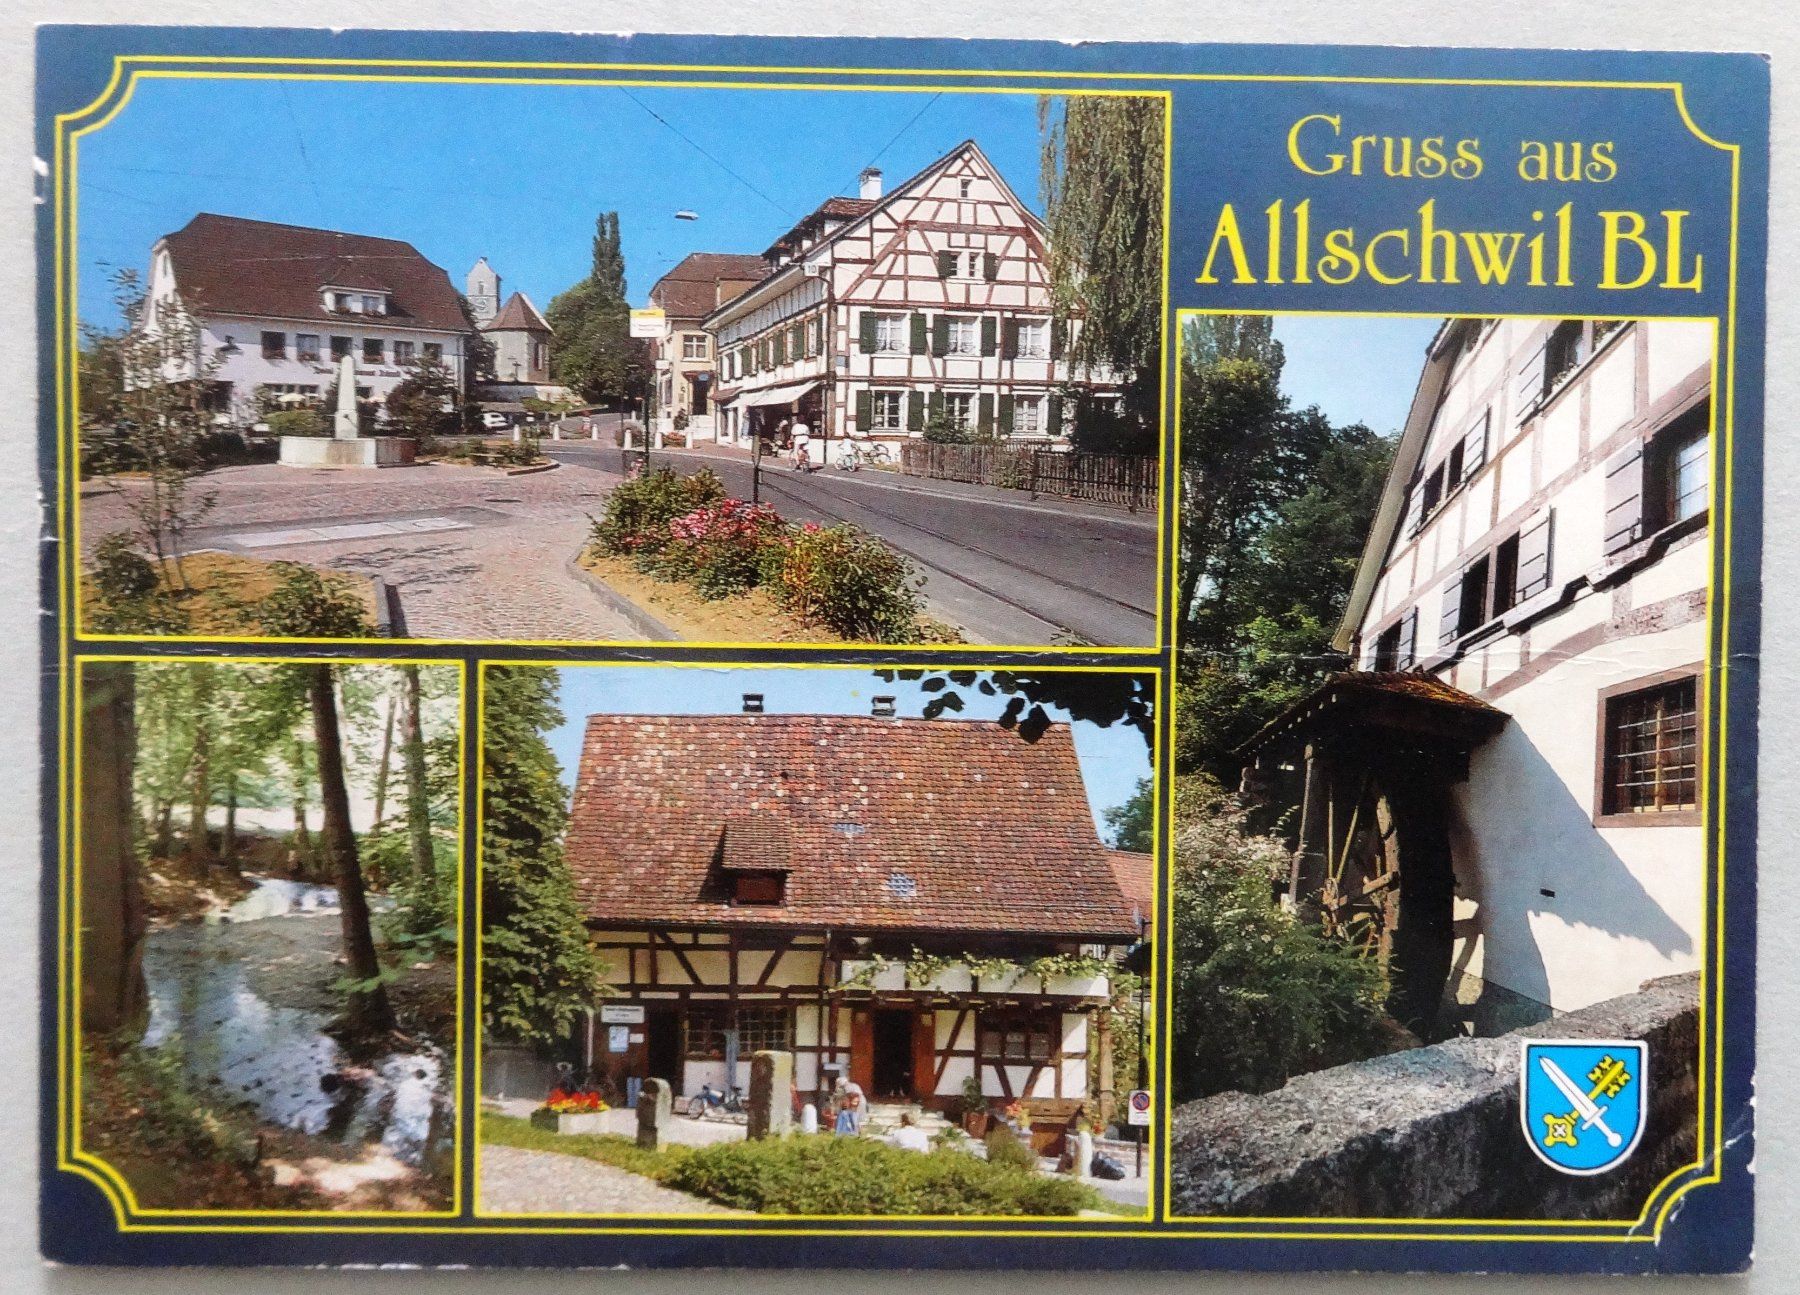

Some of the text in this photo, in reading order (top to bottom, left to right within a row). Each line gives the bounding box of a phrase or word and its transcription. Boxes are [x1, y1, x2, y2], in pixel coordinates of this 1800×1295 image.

[1286, 113, 1619, 184] Gruss aus
[1194, 197, 1705, 295] Allschwil BL
